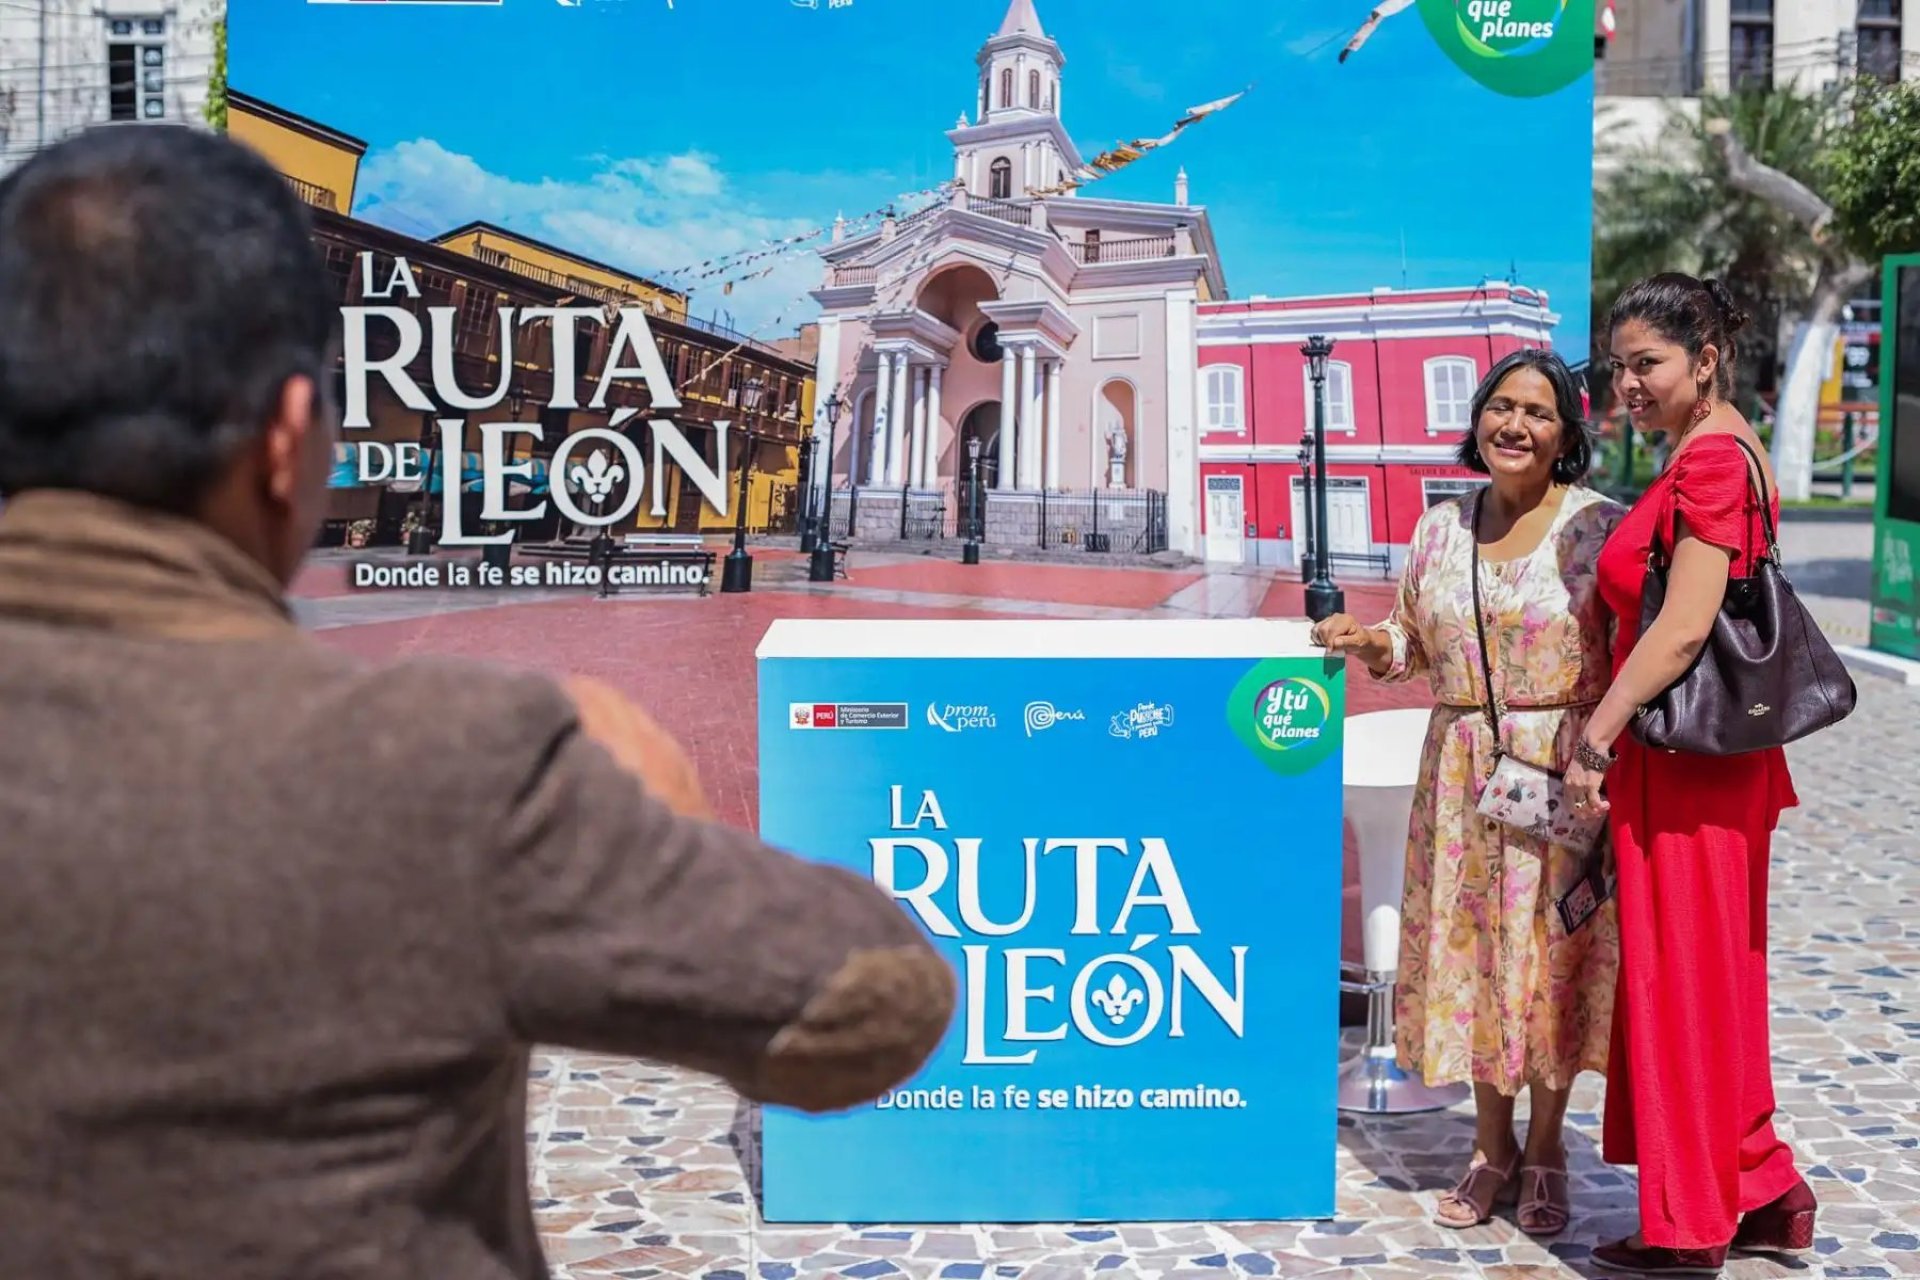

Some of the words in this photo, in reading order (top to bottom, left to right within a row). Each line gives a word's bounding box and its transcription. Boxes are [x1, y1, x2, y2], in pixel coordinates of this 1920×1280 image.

[1480, 17, 1554, 43] planes
[361, 251, 421, 298] LA
[339, 305, 682, 428] RUTA
[357, 441, 422, 482] DE
[437, 406, 731, 546] LEÓN
[355, 562, 439, 586] Donde
[448, 562, 470, 585] la
[478, 562, 503, 585] fe
[510, 568, 540, 585] se
[546, 561, 601, 585] hizo
[607, 561, 710, 585] camino.
[943, 704, 988, 720] prom
[957, 713, 996, 732] perú
[1024, 701, 1085, 738] Perú
[1263, 710, 1292, 729] qué
[1271, 725, 1320, 741] planes
[890, 785, 948, 829] LA
[868, 837, 1202, 938] RUTA
[961, 934, 1250, 1065] LEÓN
[876, 1086, 963, 1110] Donde
[972, 1085, 995, 1109] la
[1003, 1085, 1030, 1109] fe
[1037, 1090, 1068, 1109] se
[1075, 1085, 1133, 1109] hizo
[1140, 1085, 1247, 1109] camino.
